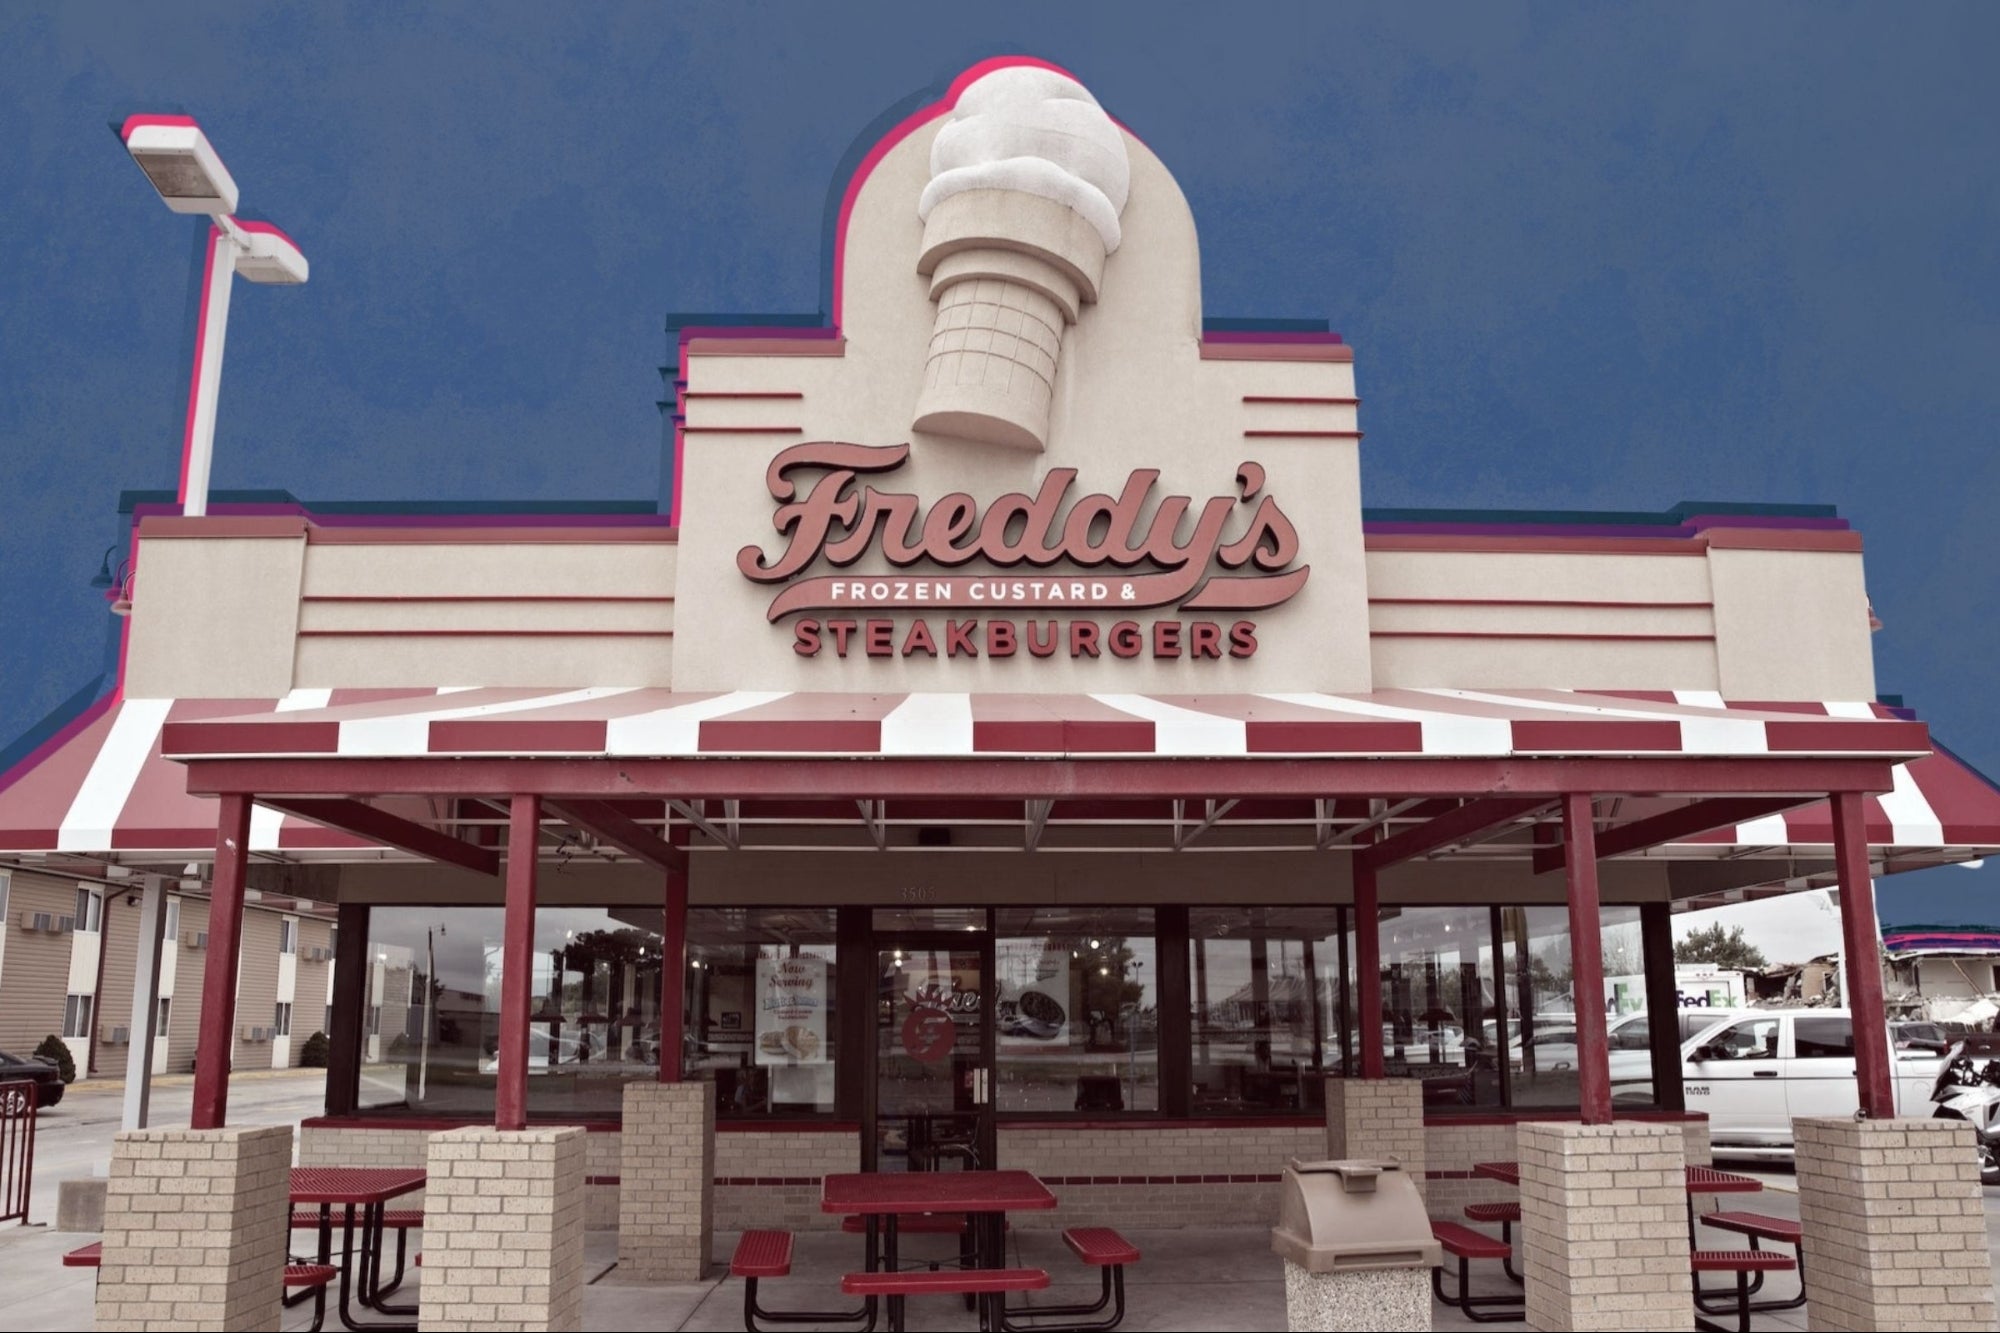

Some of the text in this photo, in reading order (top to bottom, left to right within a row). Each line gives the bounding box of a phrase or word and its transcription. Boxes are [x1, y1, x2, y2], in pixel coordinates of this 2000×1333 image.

[736, 441, 1302, 602] Freddy's
[831, 581, 1136, 600] FROZEN CUSTARD &
[793, 619, 1258, 658] STEAKBURGERS
